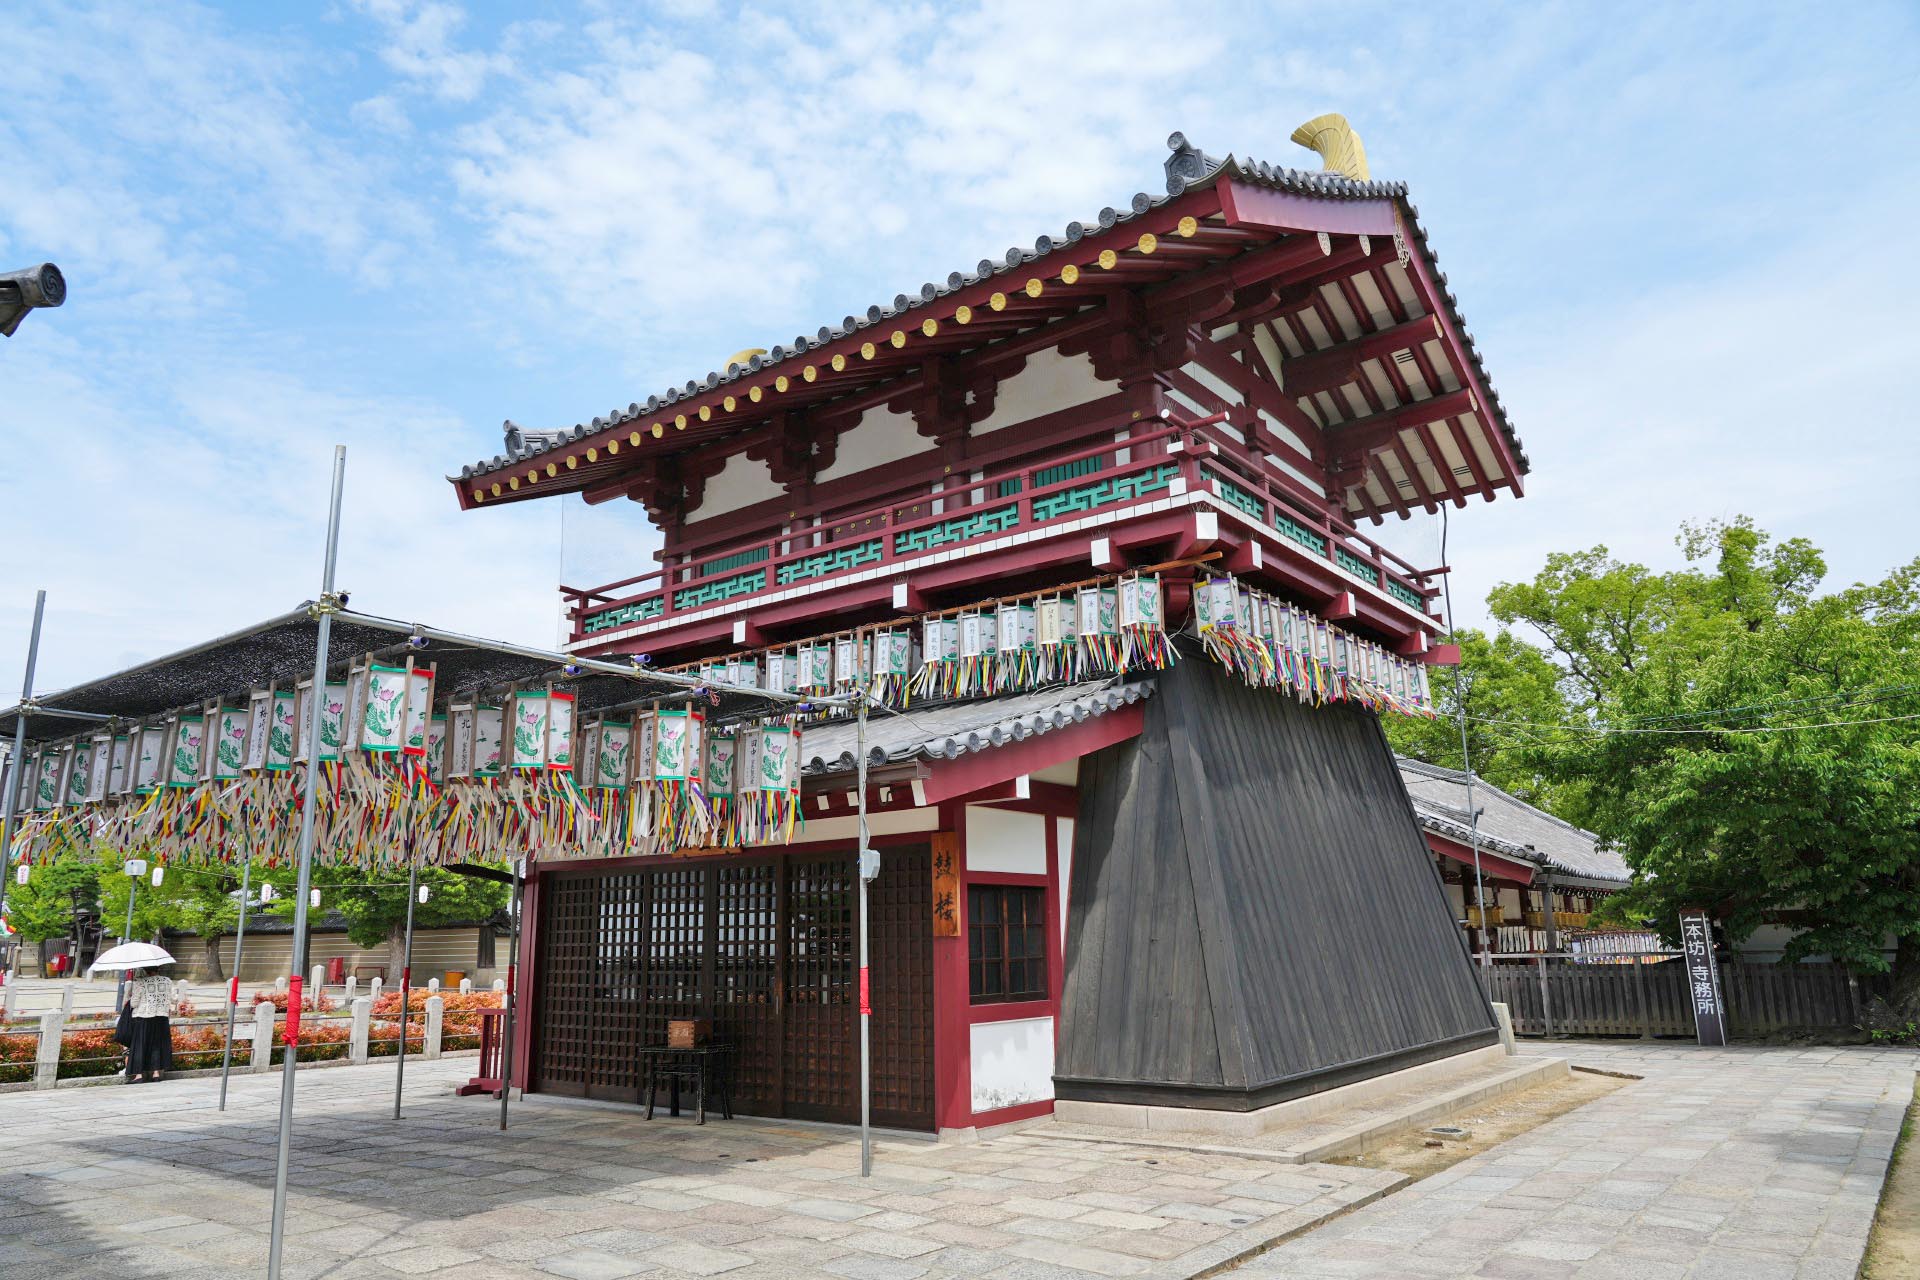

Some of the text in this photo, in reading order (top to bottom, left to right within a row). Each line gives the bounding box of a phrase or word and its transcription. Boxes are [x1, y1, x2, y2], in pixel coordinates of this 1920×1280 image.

[1685, 924, 1715, 1015] 本坊・寺務所
